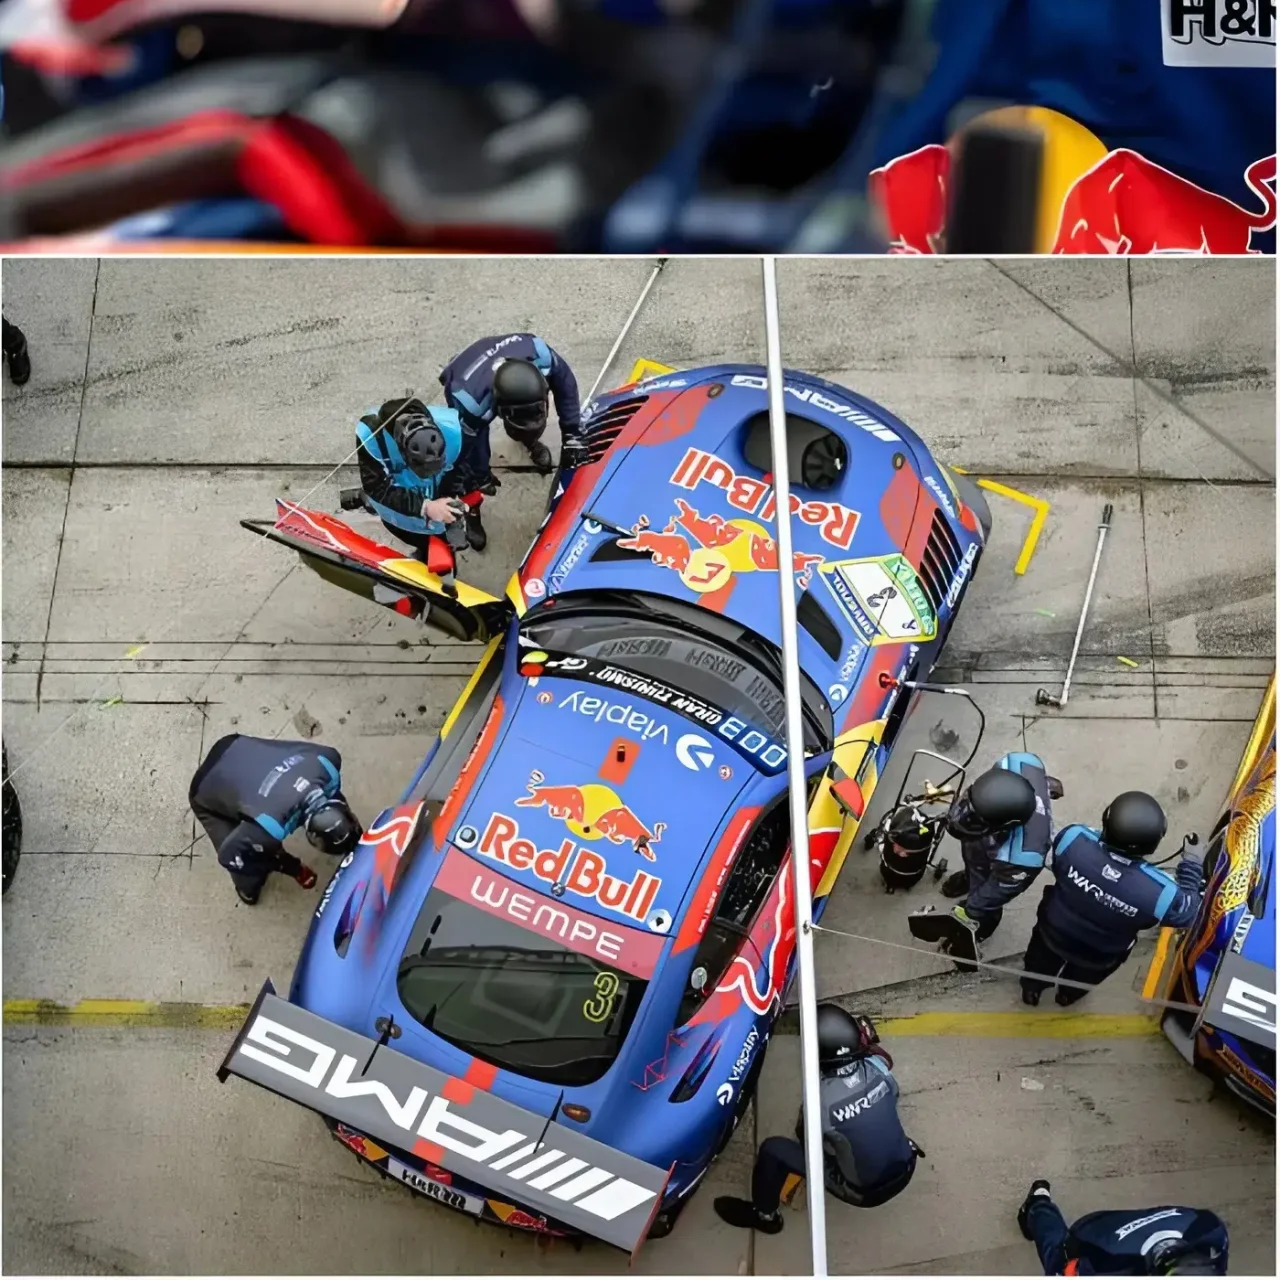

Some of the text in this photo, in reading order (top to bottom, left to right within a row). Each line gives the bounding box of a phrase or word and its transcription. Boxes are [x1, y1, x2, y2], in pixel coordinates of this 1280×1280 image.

[668, 446, 770, 515] Bull
[558, 690, 670, 746] viaplay
[477, 813, 570, 885] Red
[567, 846, 663, 924] Bull
[471, 875, 624, 960] WEMPE
[582, 971, 619, 1022] 3
